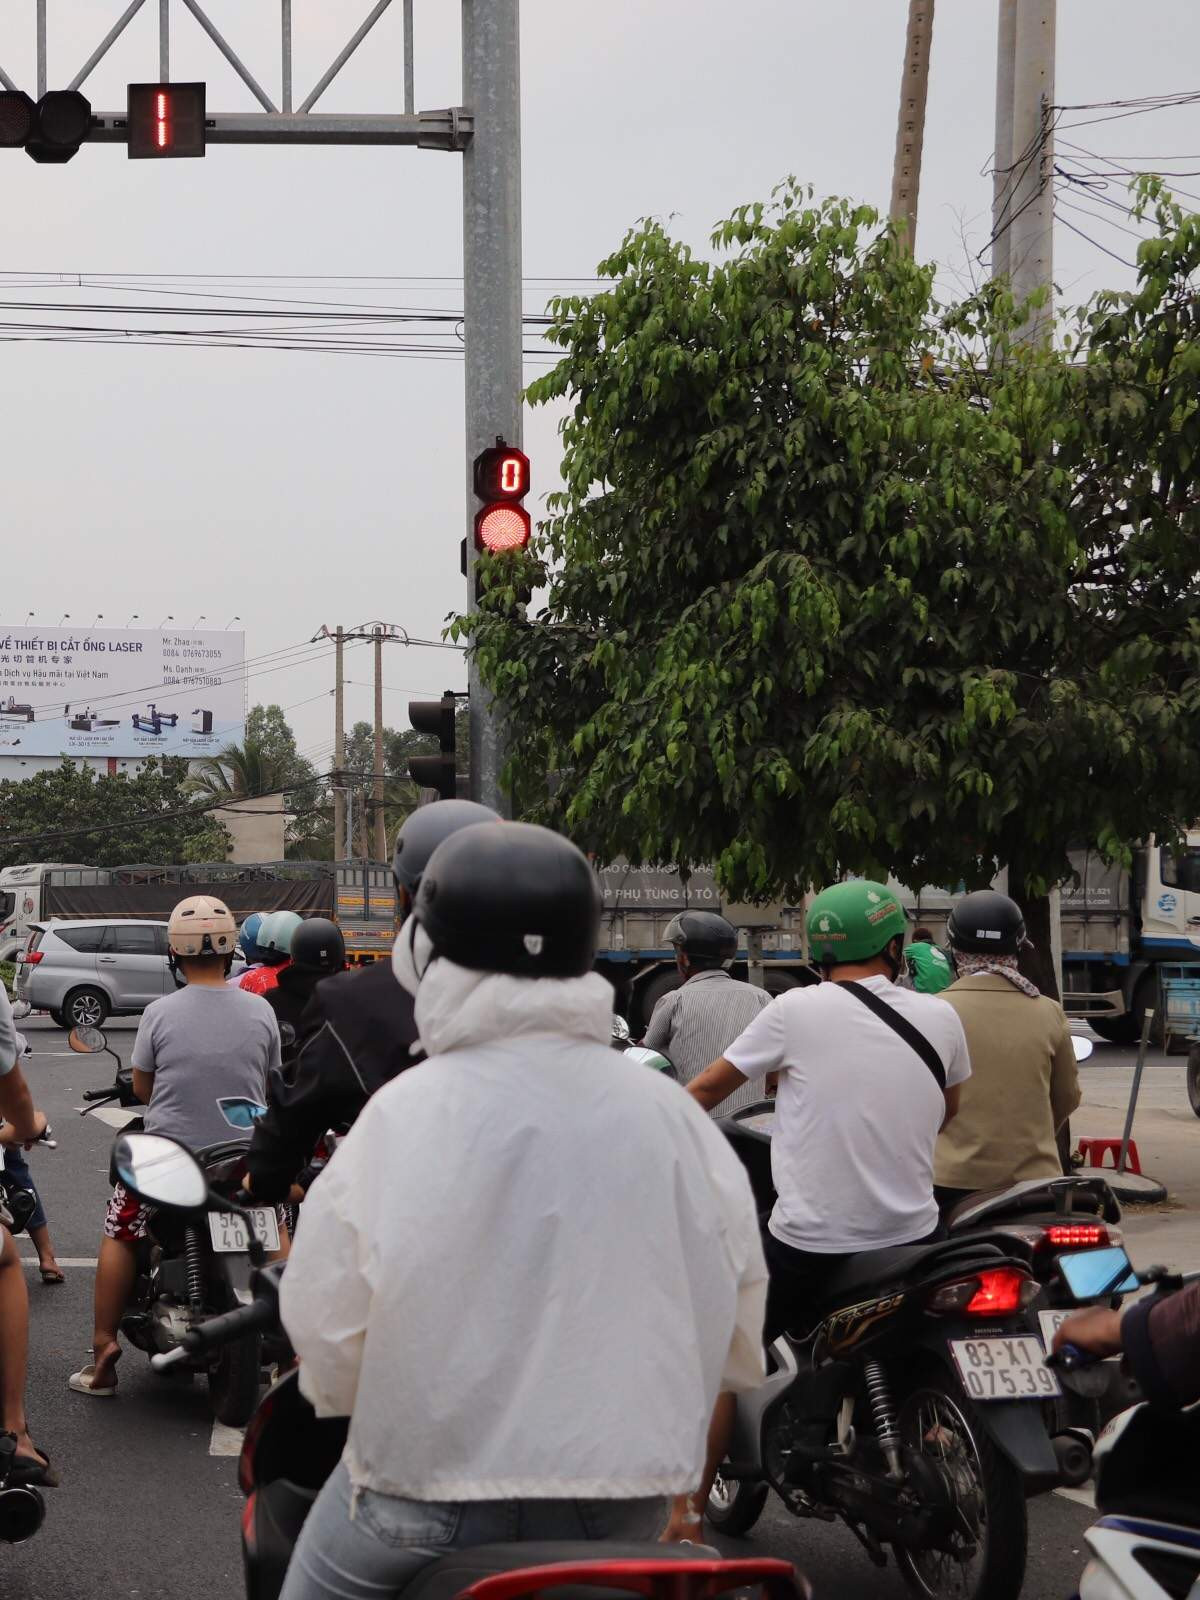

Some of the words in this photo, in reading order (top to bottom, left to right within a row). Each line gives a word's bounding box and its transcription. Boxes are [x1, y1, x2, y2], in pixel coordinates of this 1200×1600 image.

[156, 93, 166, 148] 1
[501, 459, 520, 492] 0
[14, 636, 45, 651] THIẾT
[47, 640, 58, 653] BỊ
[83, 637, 106, 652] ỐNG
[109, 642, 143, 653] LASER
[92, 670, 109, 679] Nam
[645, 886, 679, 900] TÙNG
[223, 1230, 270, 1248] 402
[964, 1340, 1033, 1368] 83-X1
[967, 1369, 1054, 1395] 075.39
